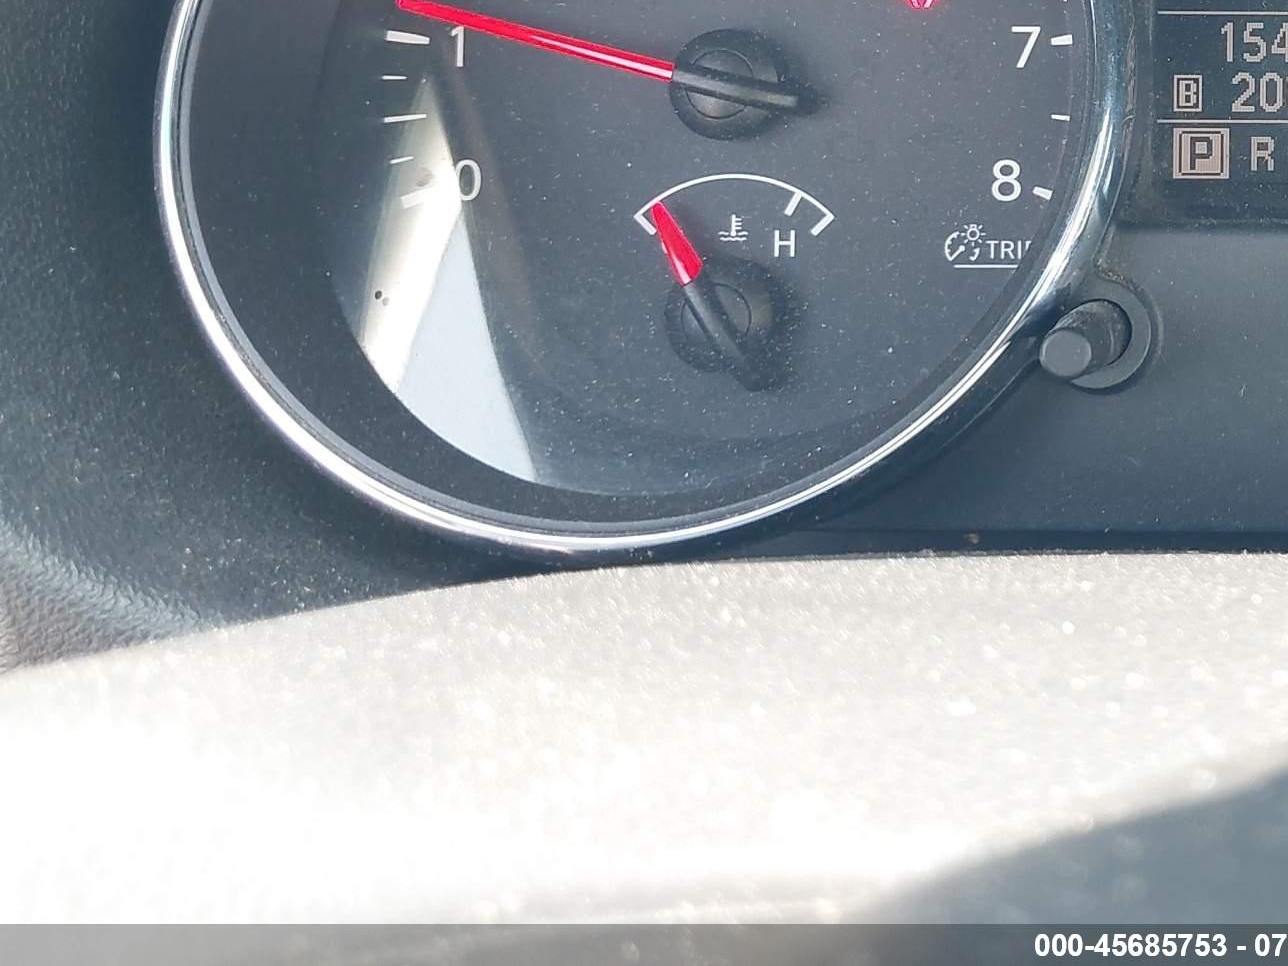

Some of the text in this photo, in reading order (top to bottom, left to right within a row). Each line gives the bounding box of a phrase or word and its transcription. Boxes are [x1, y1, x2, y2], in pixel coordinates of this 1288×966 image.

[450, 25, 465, 68] 1
[1011, 26, 1042, 67] 7
[1178, 80, 1197, 107] B
[1189, 136, 1213, 171] P
[1251, 136, 1274, 171] R
[454, 159, 482, 201] 0
[991, 160, 1021, 202] 8
[773, 230, 796, 257] H
